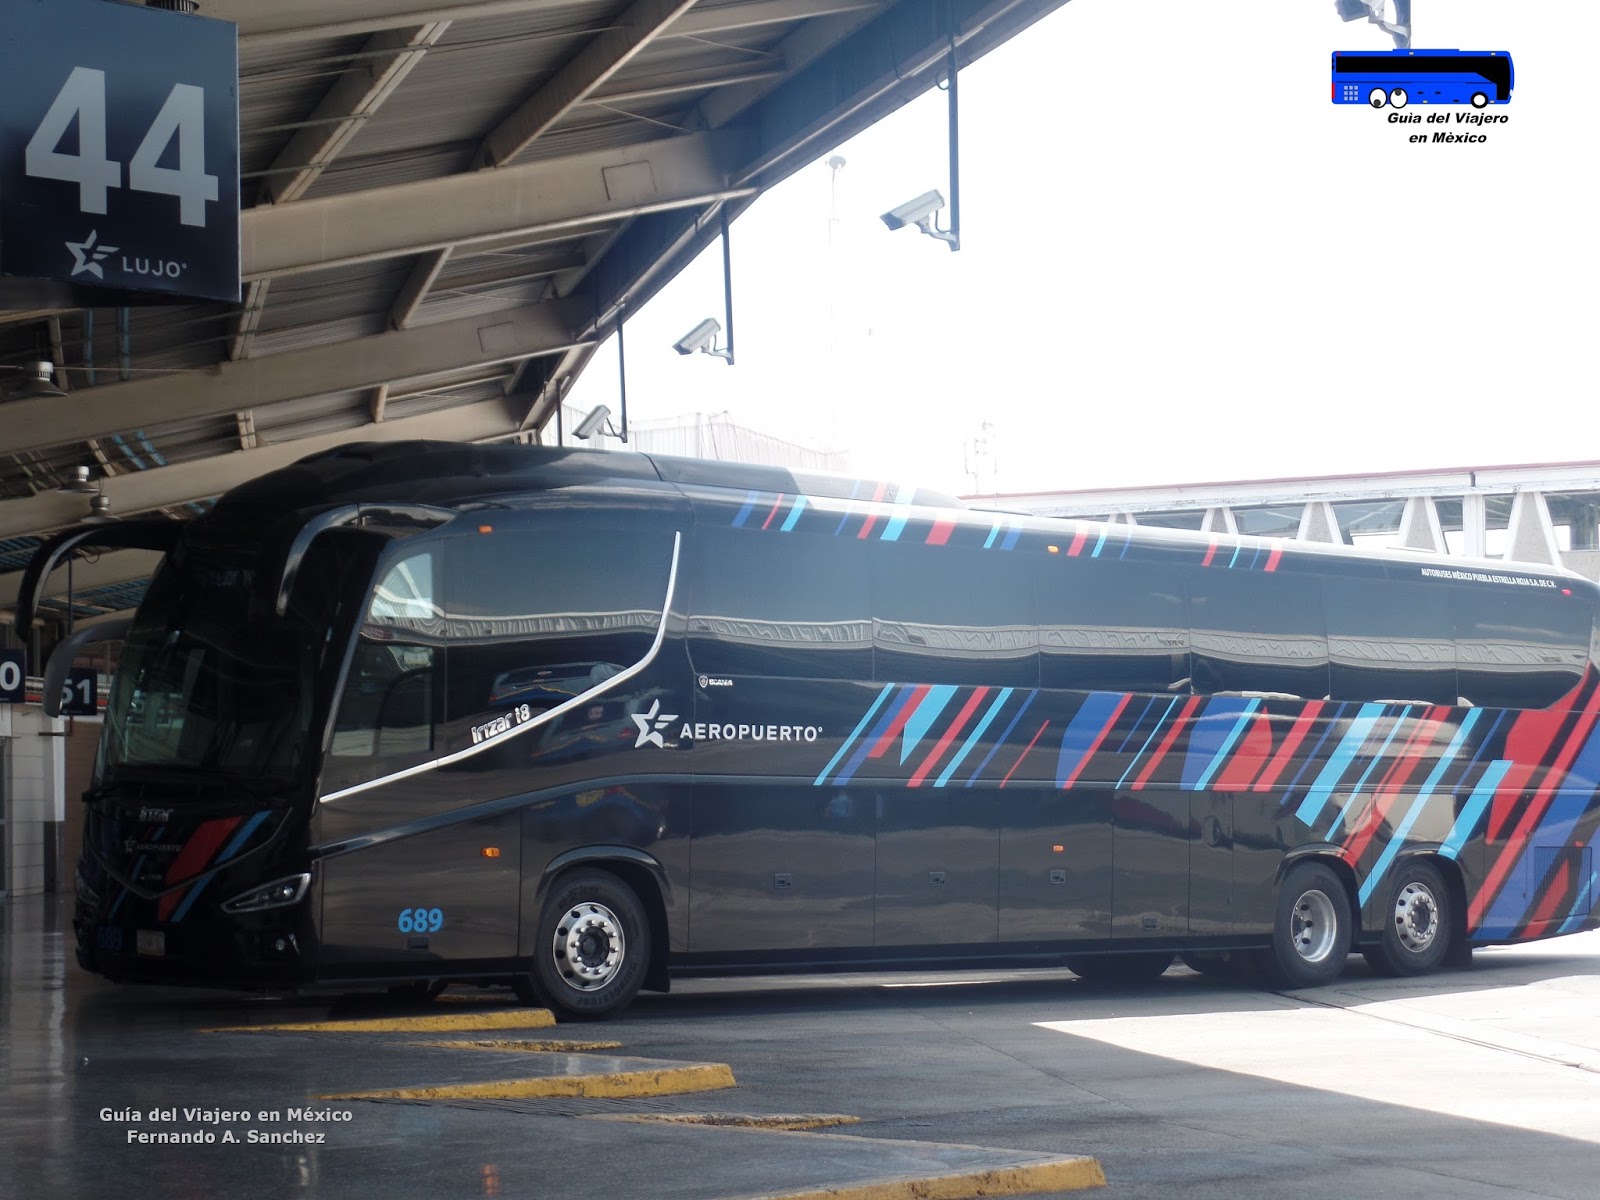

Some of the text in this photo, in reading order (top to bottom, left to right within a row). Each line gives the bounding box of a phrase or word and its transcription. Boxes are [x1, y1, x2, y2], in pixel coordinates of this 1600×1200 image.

[25, 66, 219, 228] 44
[122, 255, 181, 278] LUJO
[1421, 568, 1452, 578] AUTOBUSES
[1452, 570, 1472, 580] MÉXICO
[1472, 572, 1493, 582] PUEBLA
[1493, 575, 1516, 585] ESTRELLA
[1516, 577, 1529, 586] ROJA
[514, 703, 531, 725] i8
[679, 721, 818, 742] AEROPUERTO
[398, 908, 443, 933] 689
